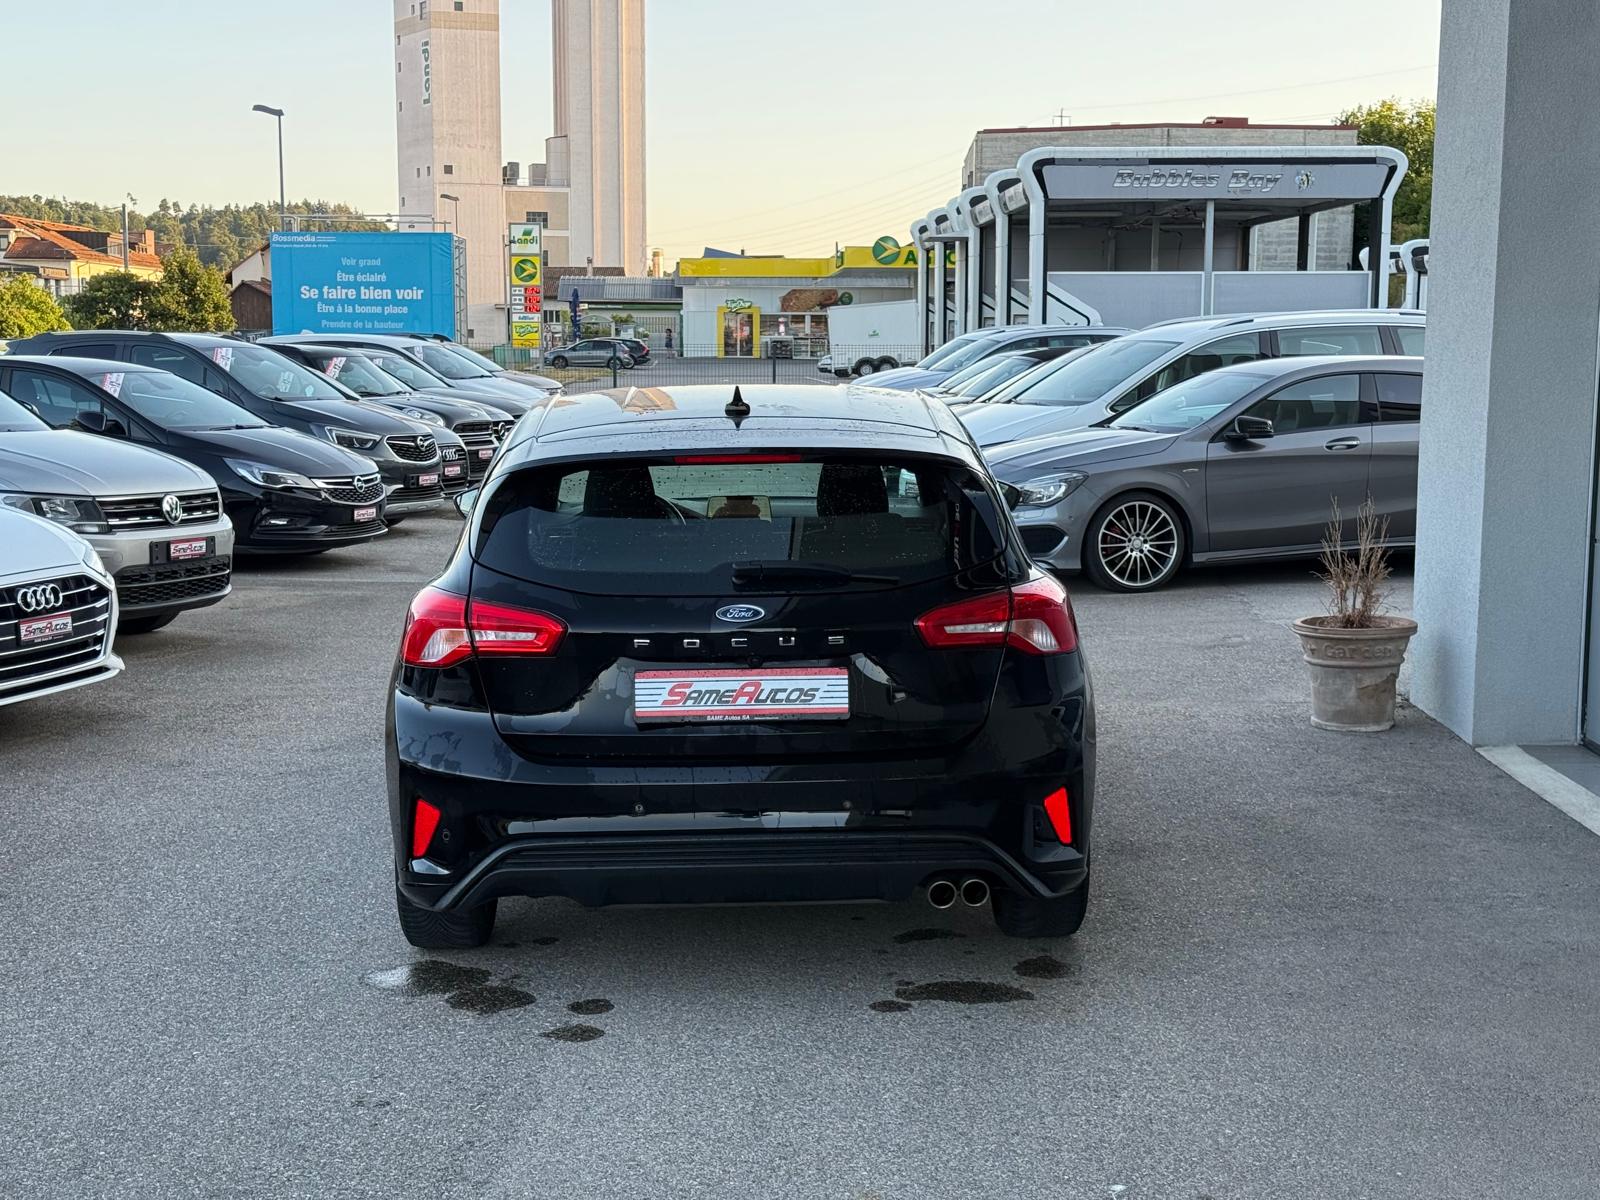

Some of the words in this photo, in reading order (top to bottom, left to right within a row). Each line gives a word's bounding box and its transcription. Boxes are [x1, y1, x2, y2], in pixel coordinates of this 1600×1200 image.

[421, 40, 431, 104] Landi
[1112, 169, 1220, 188] Bubbles
[1227, 169, 1284, 192] Bay
[272, 234, 315, 242] Bossmedia
[512, 235, 538, 245] Landi
[341, 257, 358, 266] Voir
[359, 257, 381, 267] grand
[337, 270, 355, 282] Être
[356, 271, 387, 282] éclairé
[300, 285, 319, 299] Se
[323, 285, 356, 300] faire
[360, 285, 393, 300] bien
[395, 286, 424, 300] voir
[317, 304, 335, 313] Être
[336, 304, 343, 313] à
[344, 304, 353, 313] la
[355, 304, 383, 313] bonne
[384, 304, 408, 315] place
[321, 320, 351, 329] Prendre
[353, 320, 363, 329] de
[365, 320, 372, 329] la
[374, 320, 404, 329] hauteur
[633, 636, 845, 648] FOCUS
[1324, 643, 1393, 660] Garden
